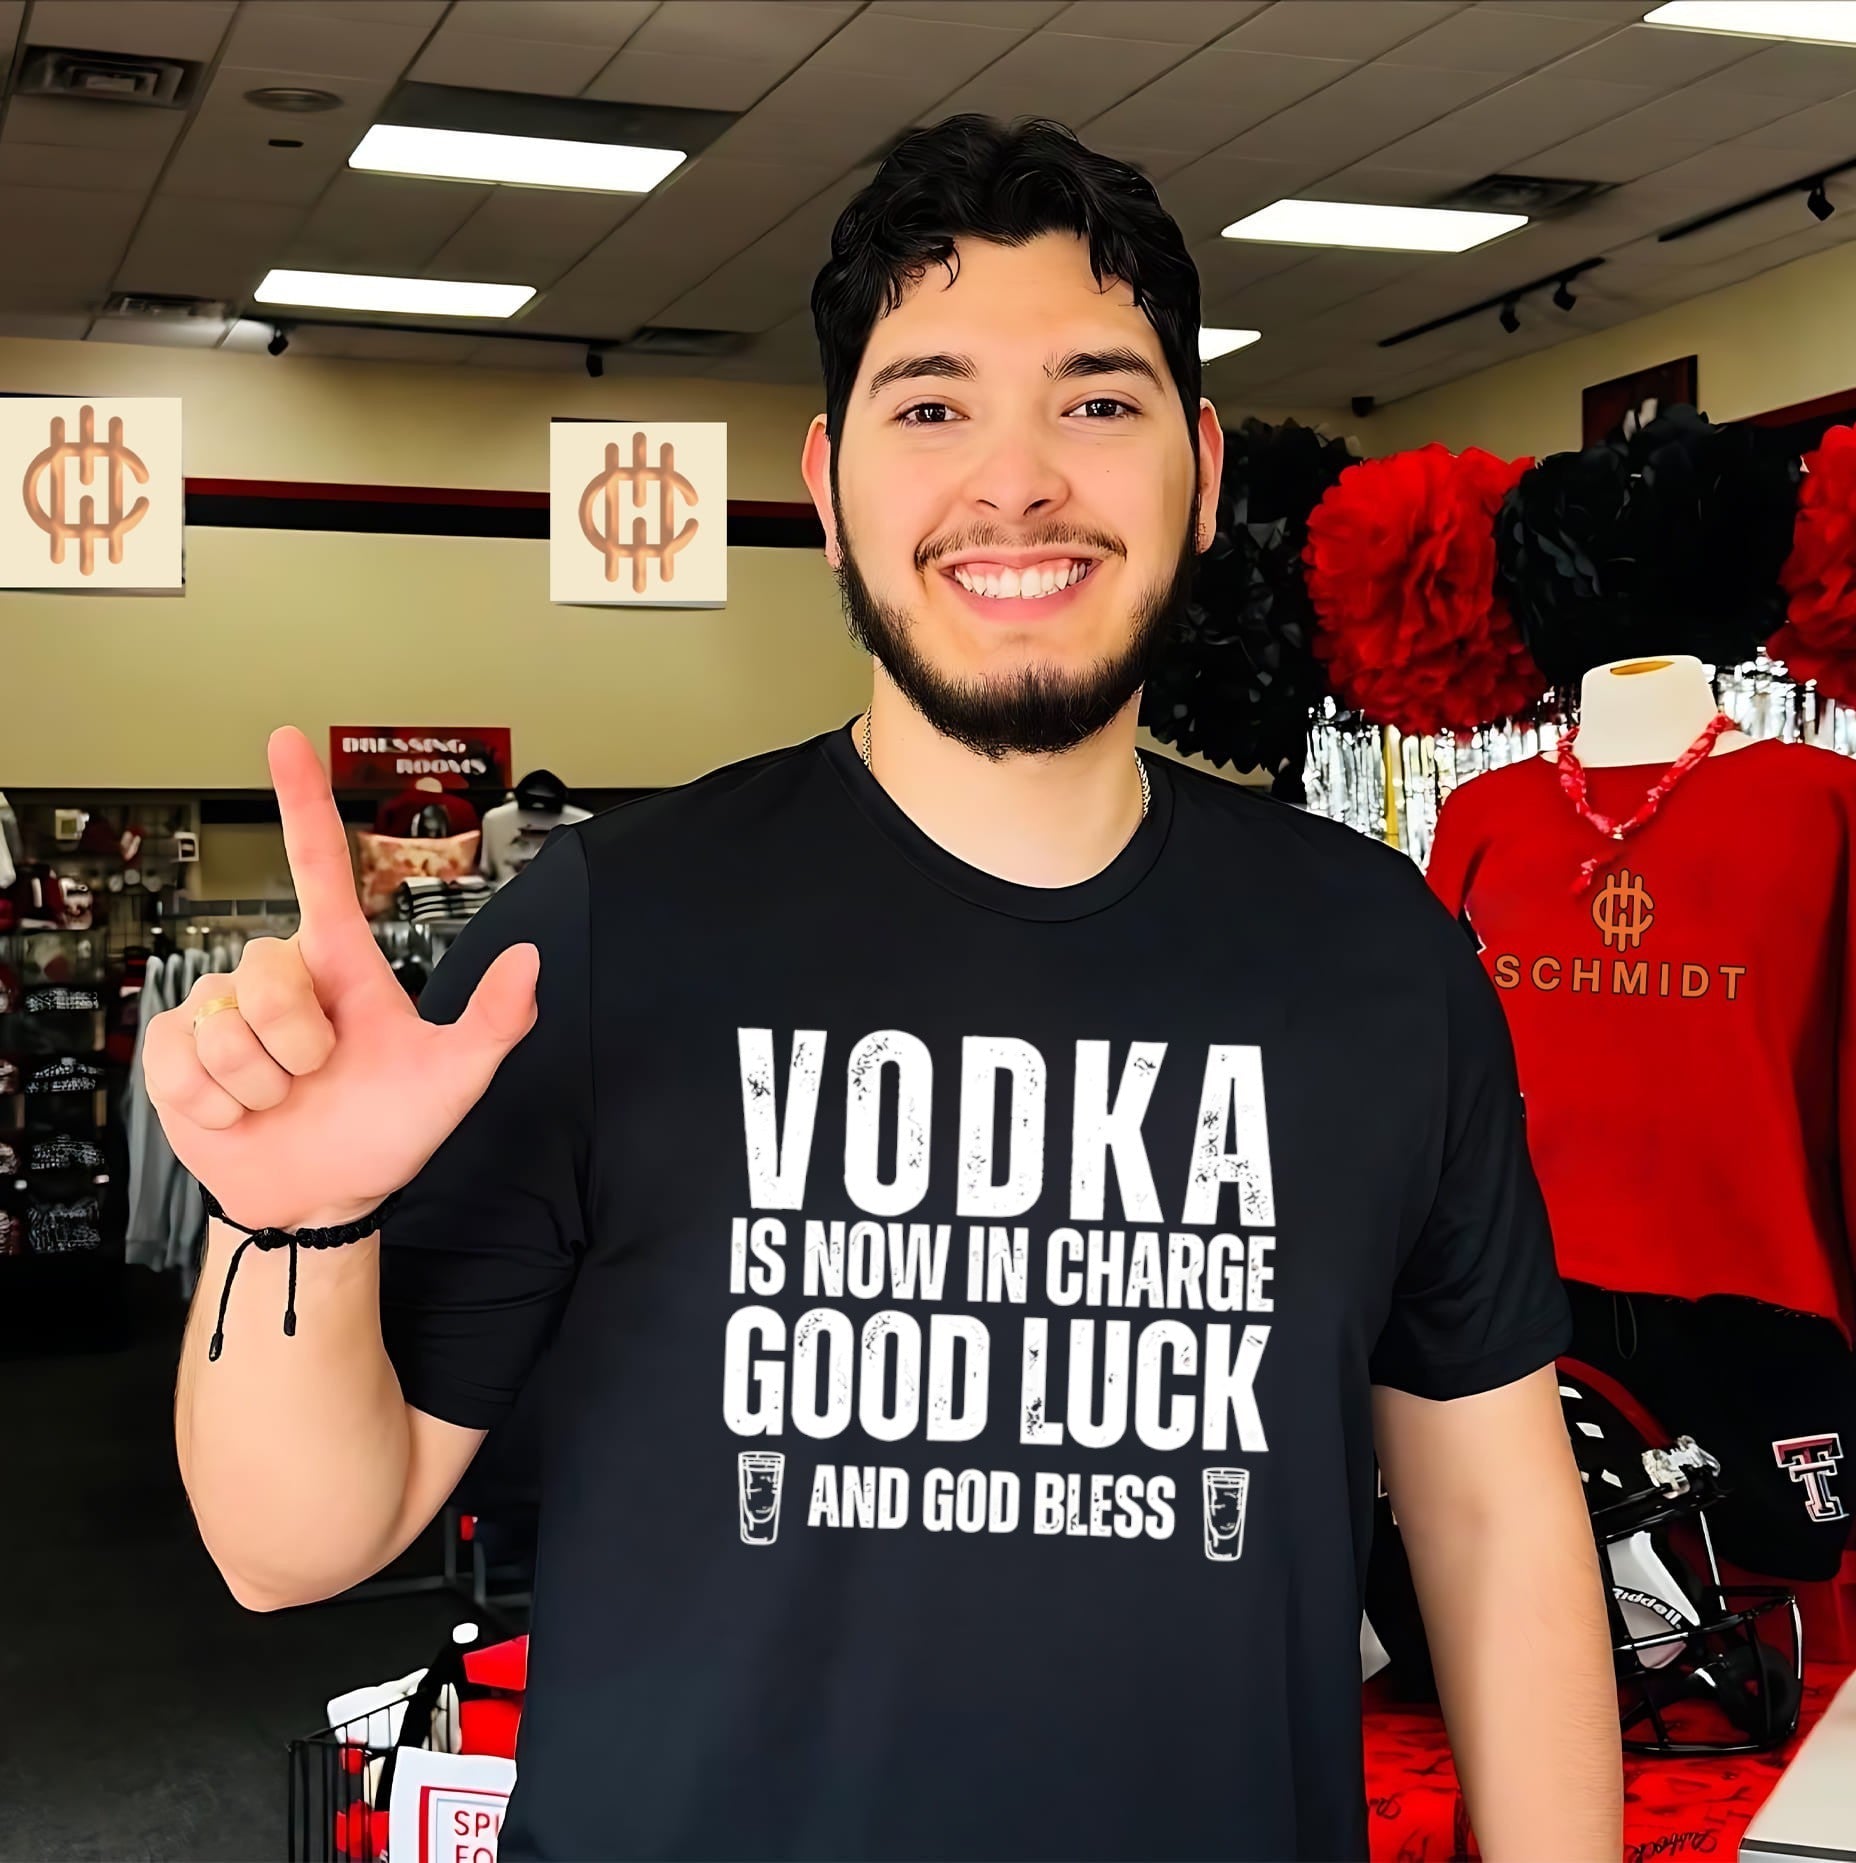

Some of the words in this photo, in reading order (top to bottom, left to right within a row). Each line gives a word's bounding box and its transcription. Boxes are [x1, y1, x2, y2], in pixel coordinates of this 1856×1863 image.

[342, 737, 467, 754] DRESSING
[396, 758, 487, 775] ROOMS
[1494, 954, 1746, 1000] SCHMIDT
[737, 1027, 1276, 1227] VODKA
[730, 1217, 787, 1296] IS
[803, 1219, 952, 1301] NOW
[967, 1226, 1029, 1304] IN
[1046, 1228, 1277, 1313] CHARGE
[722, 1305, 991, 1442] GOOD
[1019, 1317, 1272, 1452] LUCK
[807, 1464, 910, 1529] AND
[922, 1468, 1021, 1534] GOD
[1033, 1472, 1176, 1540] BLESS
